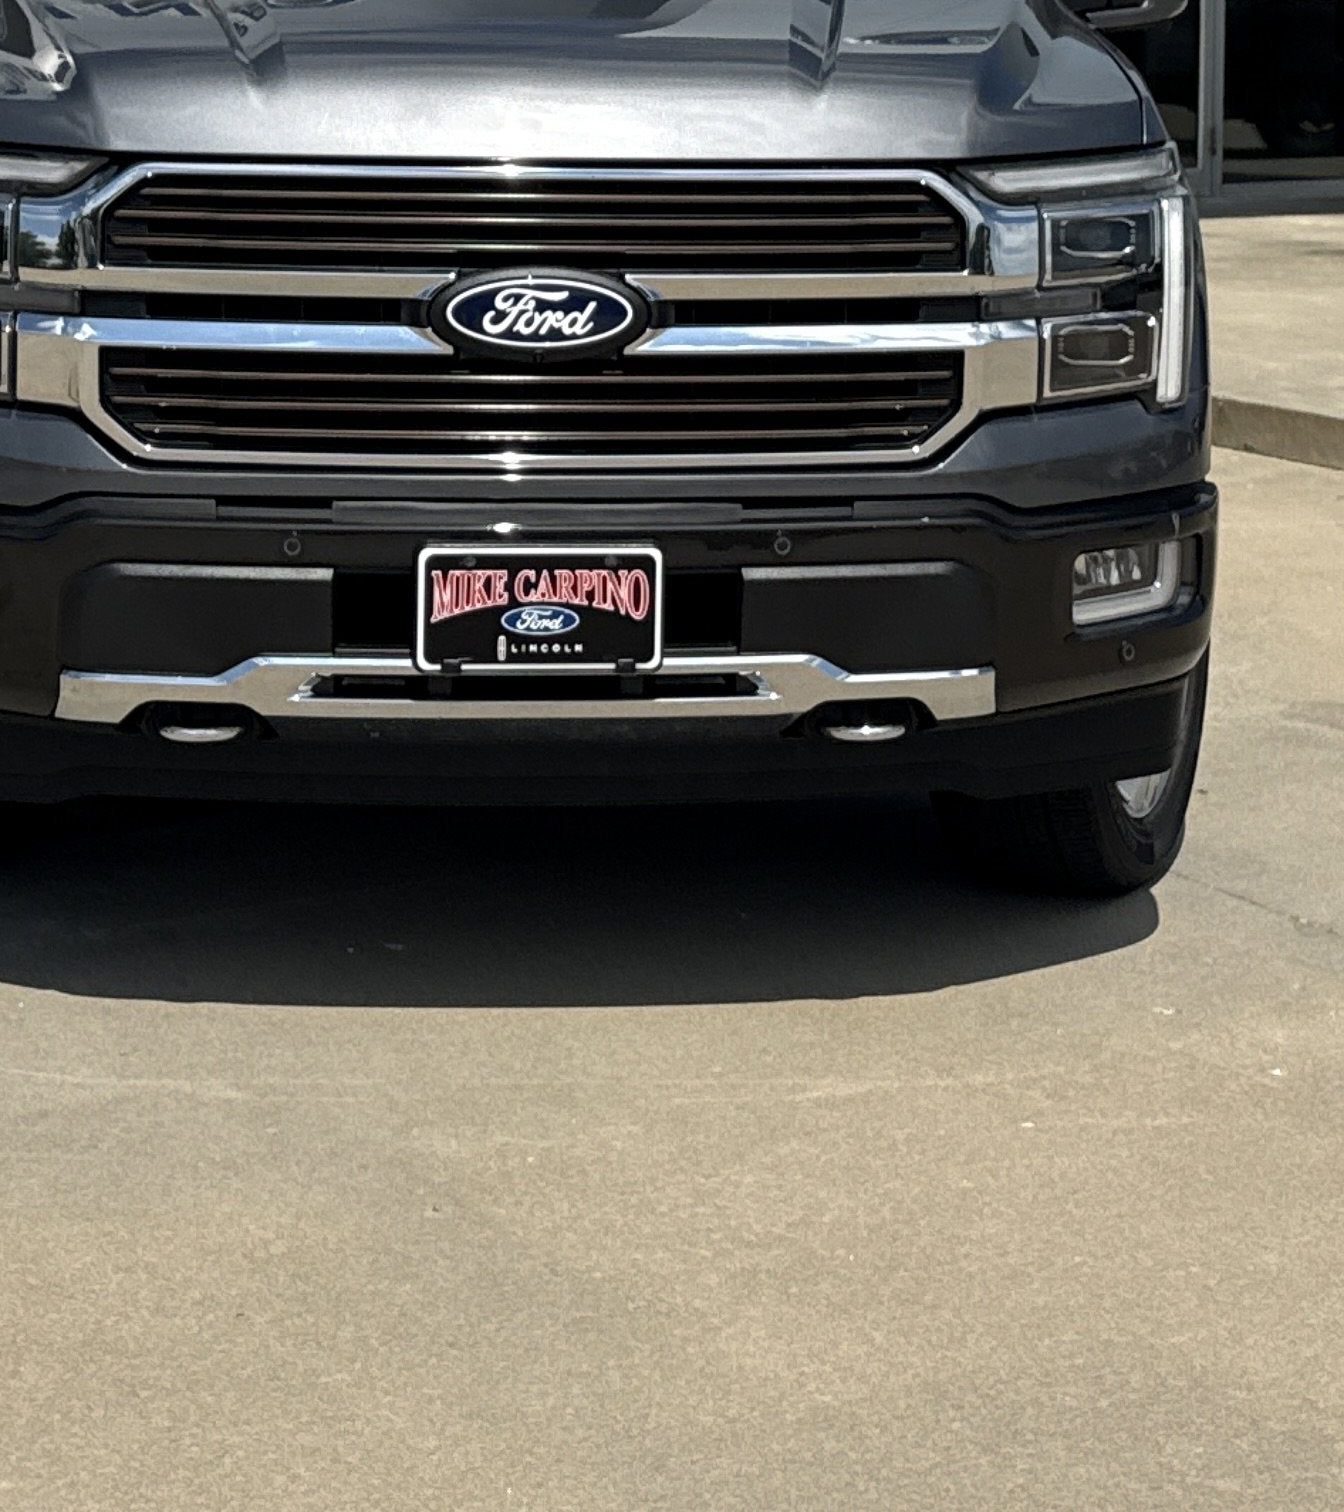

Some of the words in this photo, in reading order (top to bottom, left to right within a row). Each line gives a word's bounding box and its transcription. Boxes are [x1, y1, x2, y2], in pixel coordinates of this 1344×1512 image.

[482, 288, 597, 335] Ford
[430, 569, 508, 623] MIKE
[514, 568, 649, 620] CARPINO
[516, 609, 563, 630] Ford
[511, 643, 583, 653] LINCOLN
